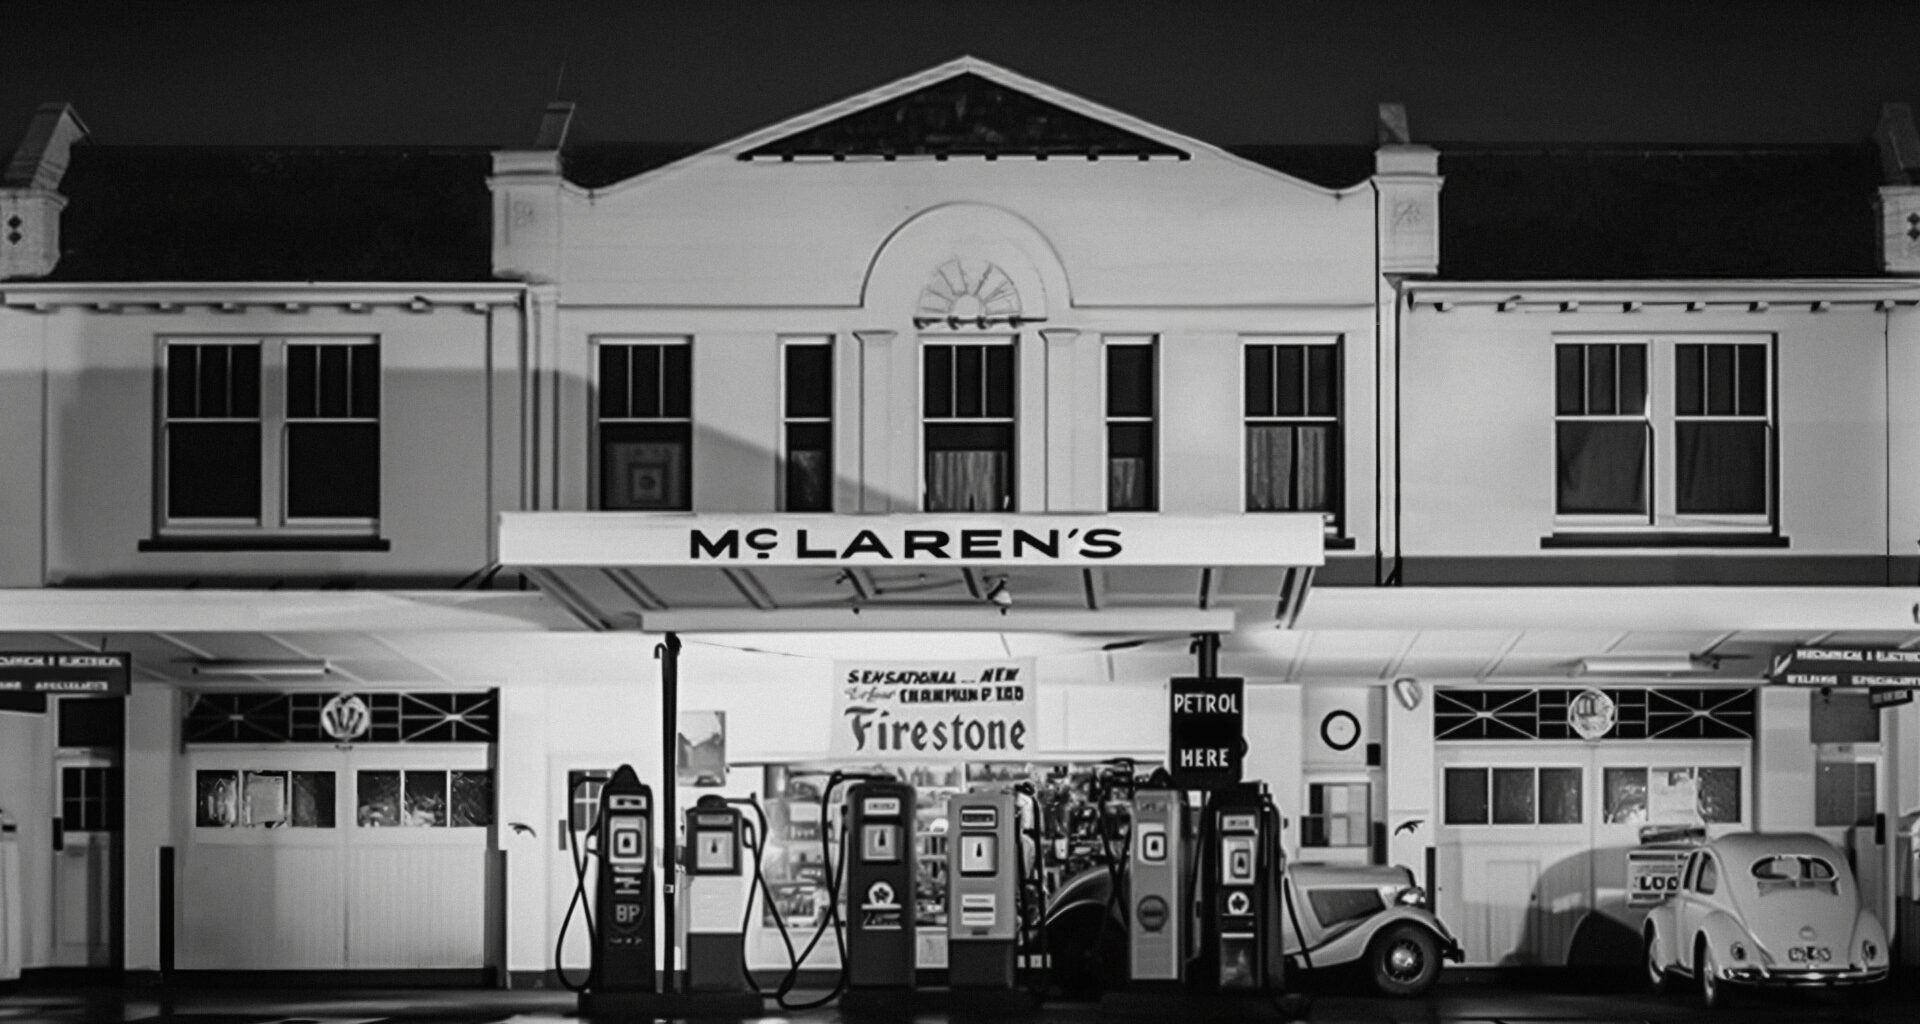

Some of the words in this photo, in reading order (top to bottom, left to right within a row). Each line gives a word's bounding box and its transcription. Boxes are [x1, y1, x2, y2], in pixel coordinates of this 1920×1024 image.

[847, 669, 956, 684] SENSATIONAL
[1174, 692, 1239, 714] PETROL
[844, 706, 1026, 751] Firestone
[1181, 748, 1229, 767] HERE
[616, 904, 640, 922] BP
